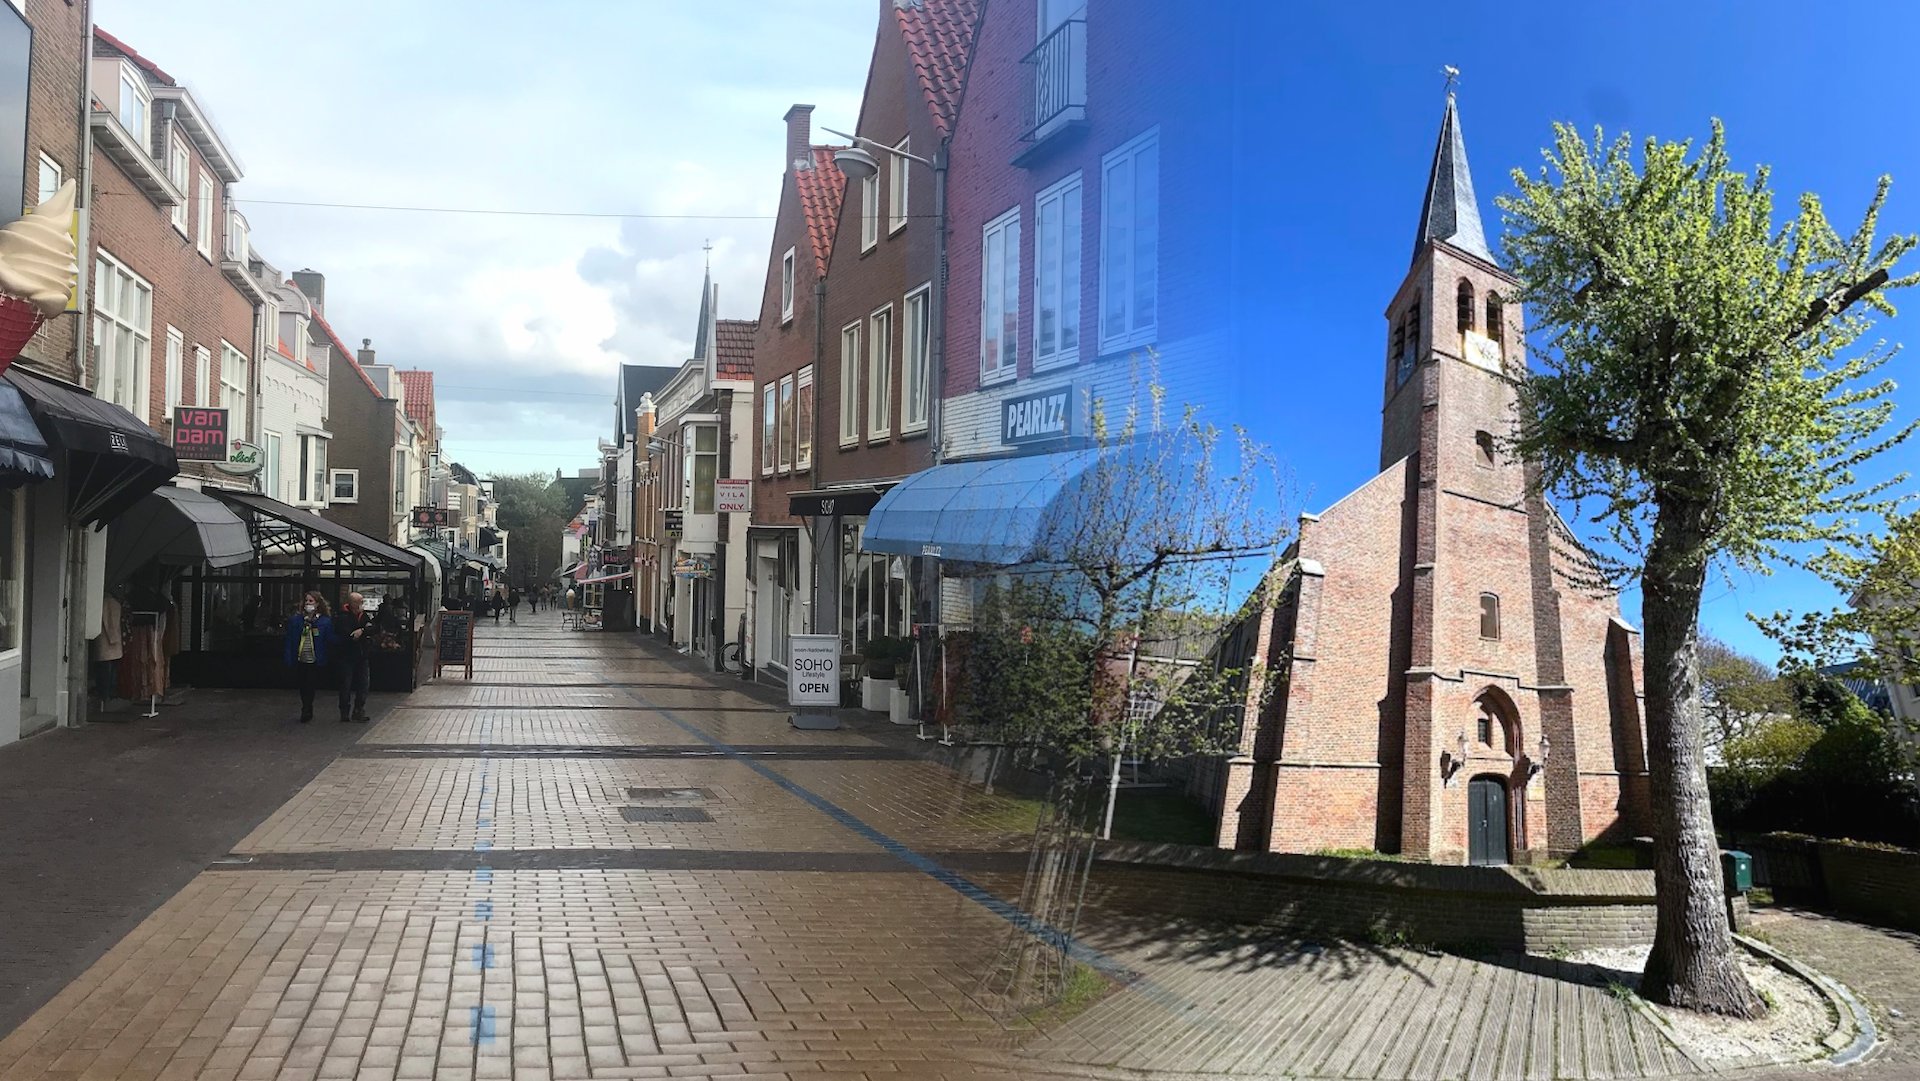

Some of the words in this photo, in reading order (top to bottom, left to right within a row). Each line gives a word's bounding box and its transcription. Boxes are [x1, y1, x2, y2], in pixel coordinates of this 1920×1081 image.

[181, 410, 222, 426] van
[1007, 393, 1067, 439] PEARLZZ
[230, 451, 257, 463] olsch
[821, 498, 835, 515] SOHO
[794, 658, 833, 671] SOHO
[802, 671, 826, 679] Lifestyle
[799, 682, 829, 693] OPEN
